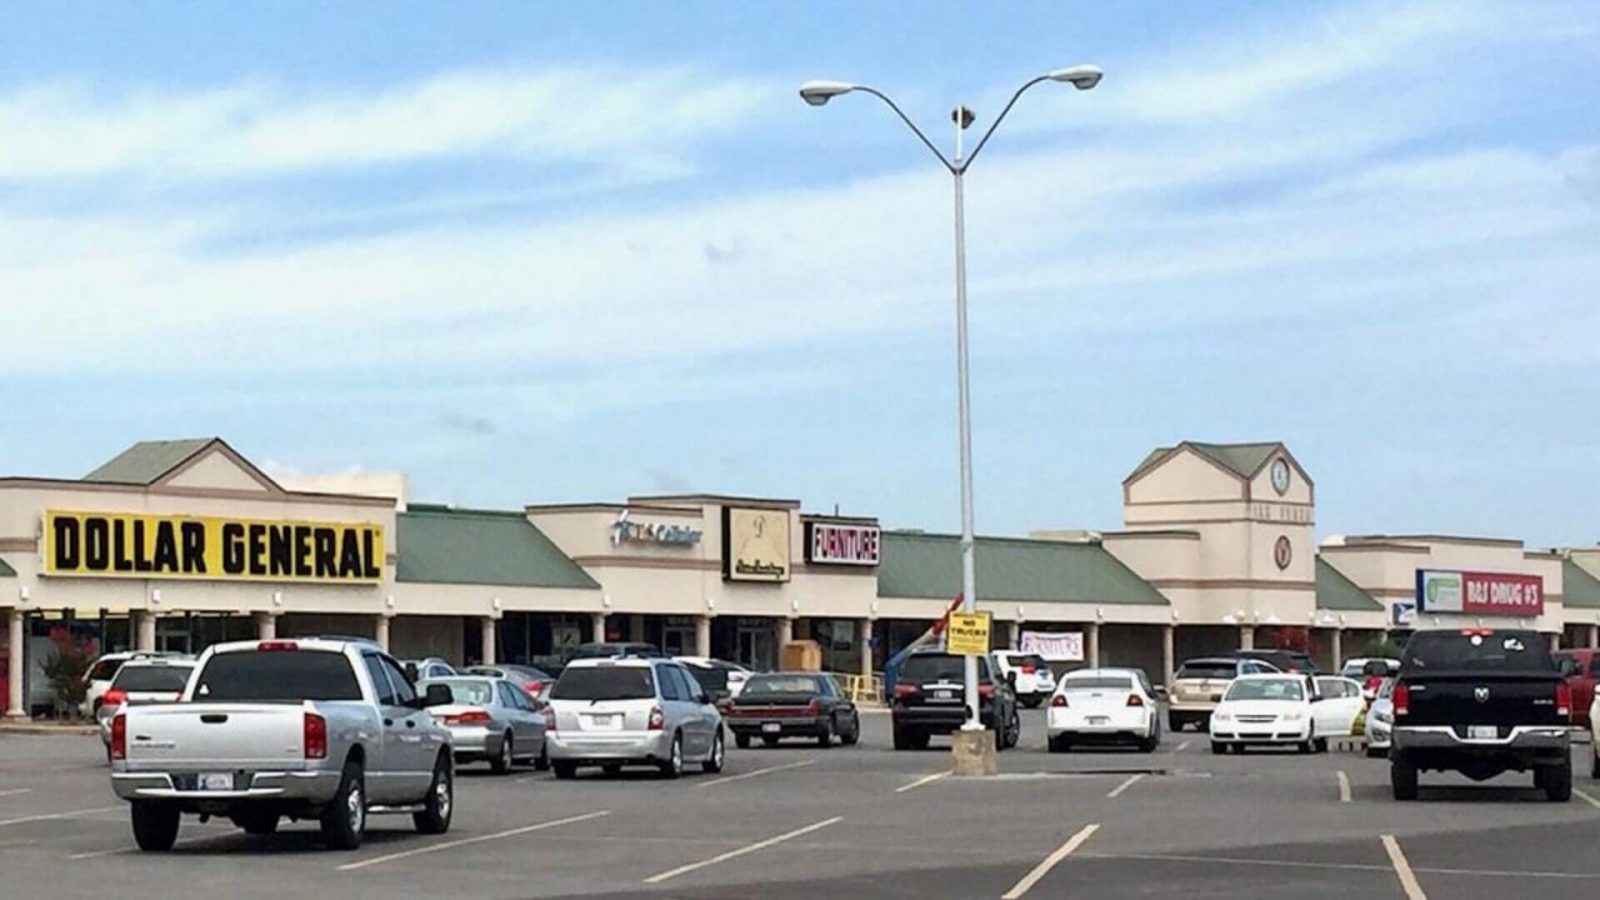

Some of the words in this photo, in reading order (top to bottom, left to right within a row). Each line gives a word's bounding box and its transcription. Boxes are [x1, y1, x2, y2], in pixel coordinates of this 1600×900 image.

[54, 516, 206, 573] DOLLAR
[222, 523, 381, 578] GENERAL
[814, 527, 877, 561] FURNITURE
[1490, 582, 1522, 605] DRUG
[1524, 584, 1539, 606] #3
[951, 627, 987, 637] TRUCKS
[963, 619, 976, 627] NO
